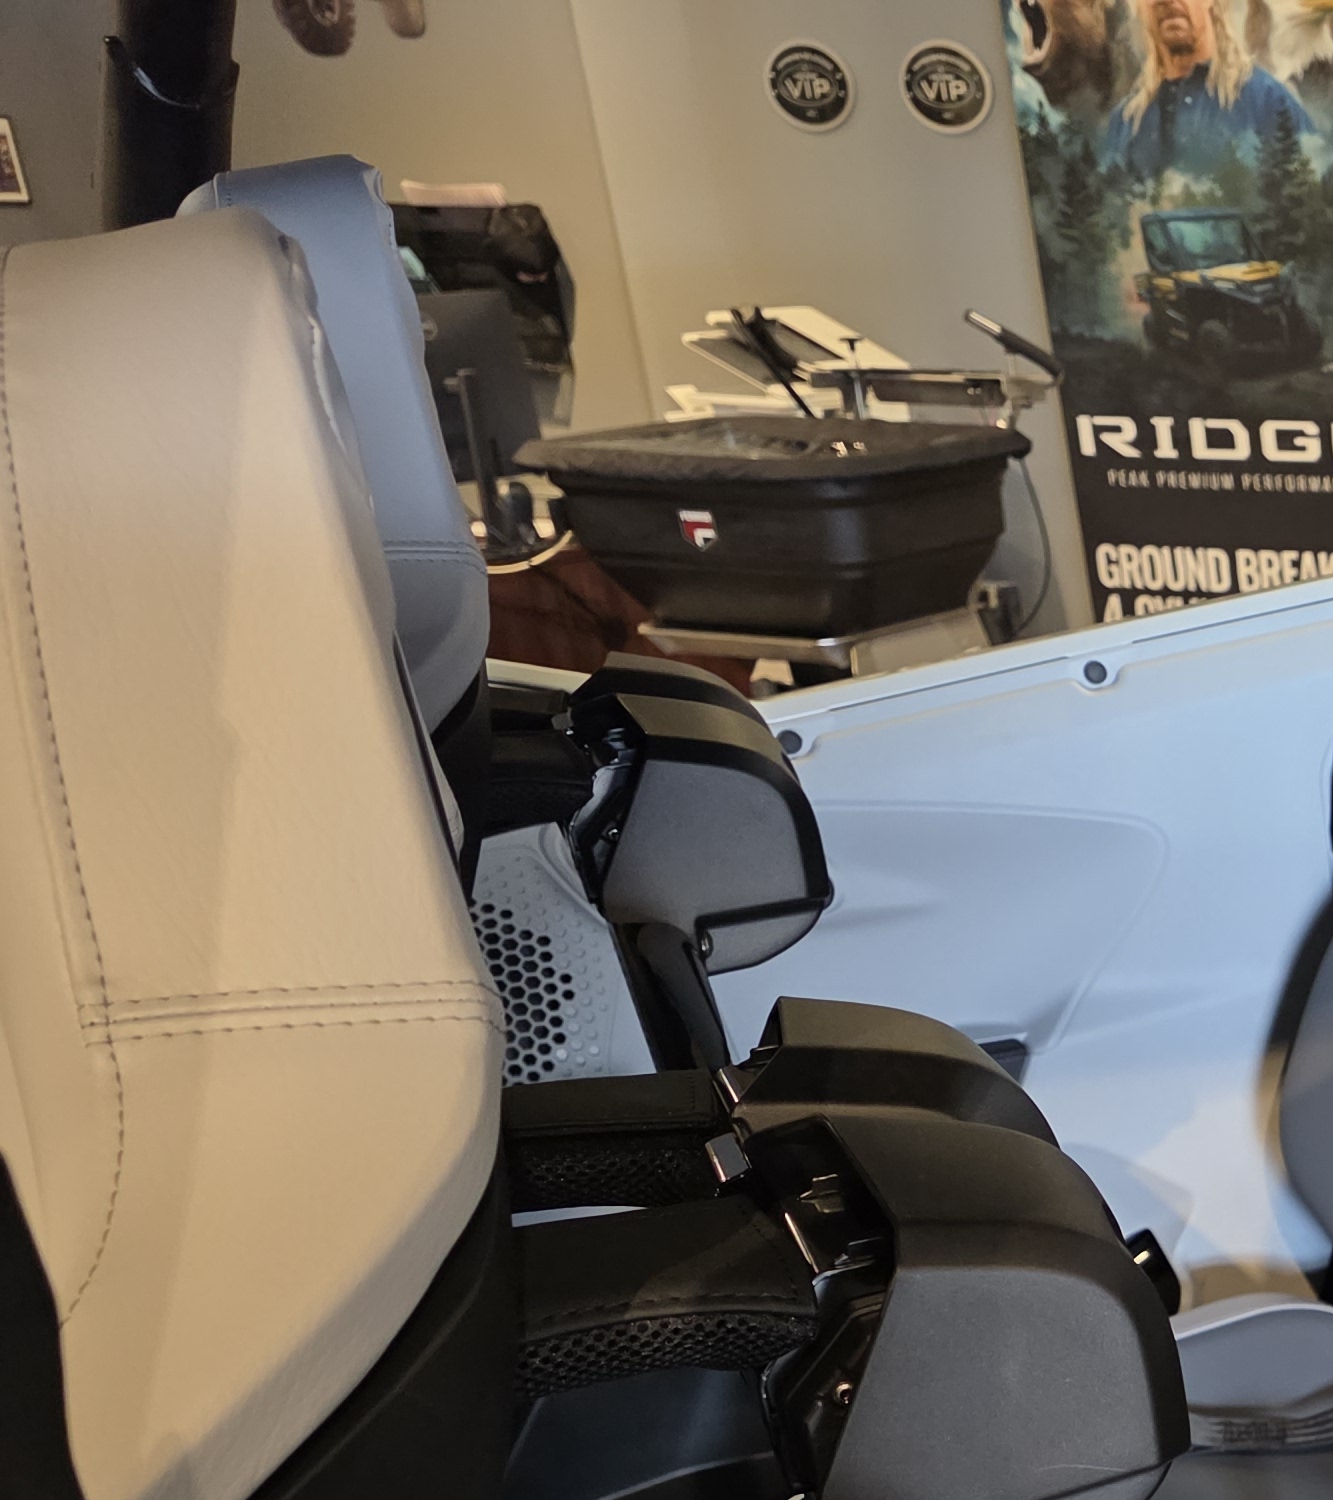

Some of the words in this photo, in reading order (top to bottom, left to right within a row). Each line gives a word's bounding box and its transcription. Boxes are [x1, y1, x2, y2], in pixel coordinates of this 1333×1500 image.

[784, 78, 830, 99] VIP
[920, 80, 967, 101] VIP
[1107, 468, 1149, 488] PEAK
[1155, 470, 1234, 491] PREMIUM
[1095, 542, 1232, 593] GROUND
